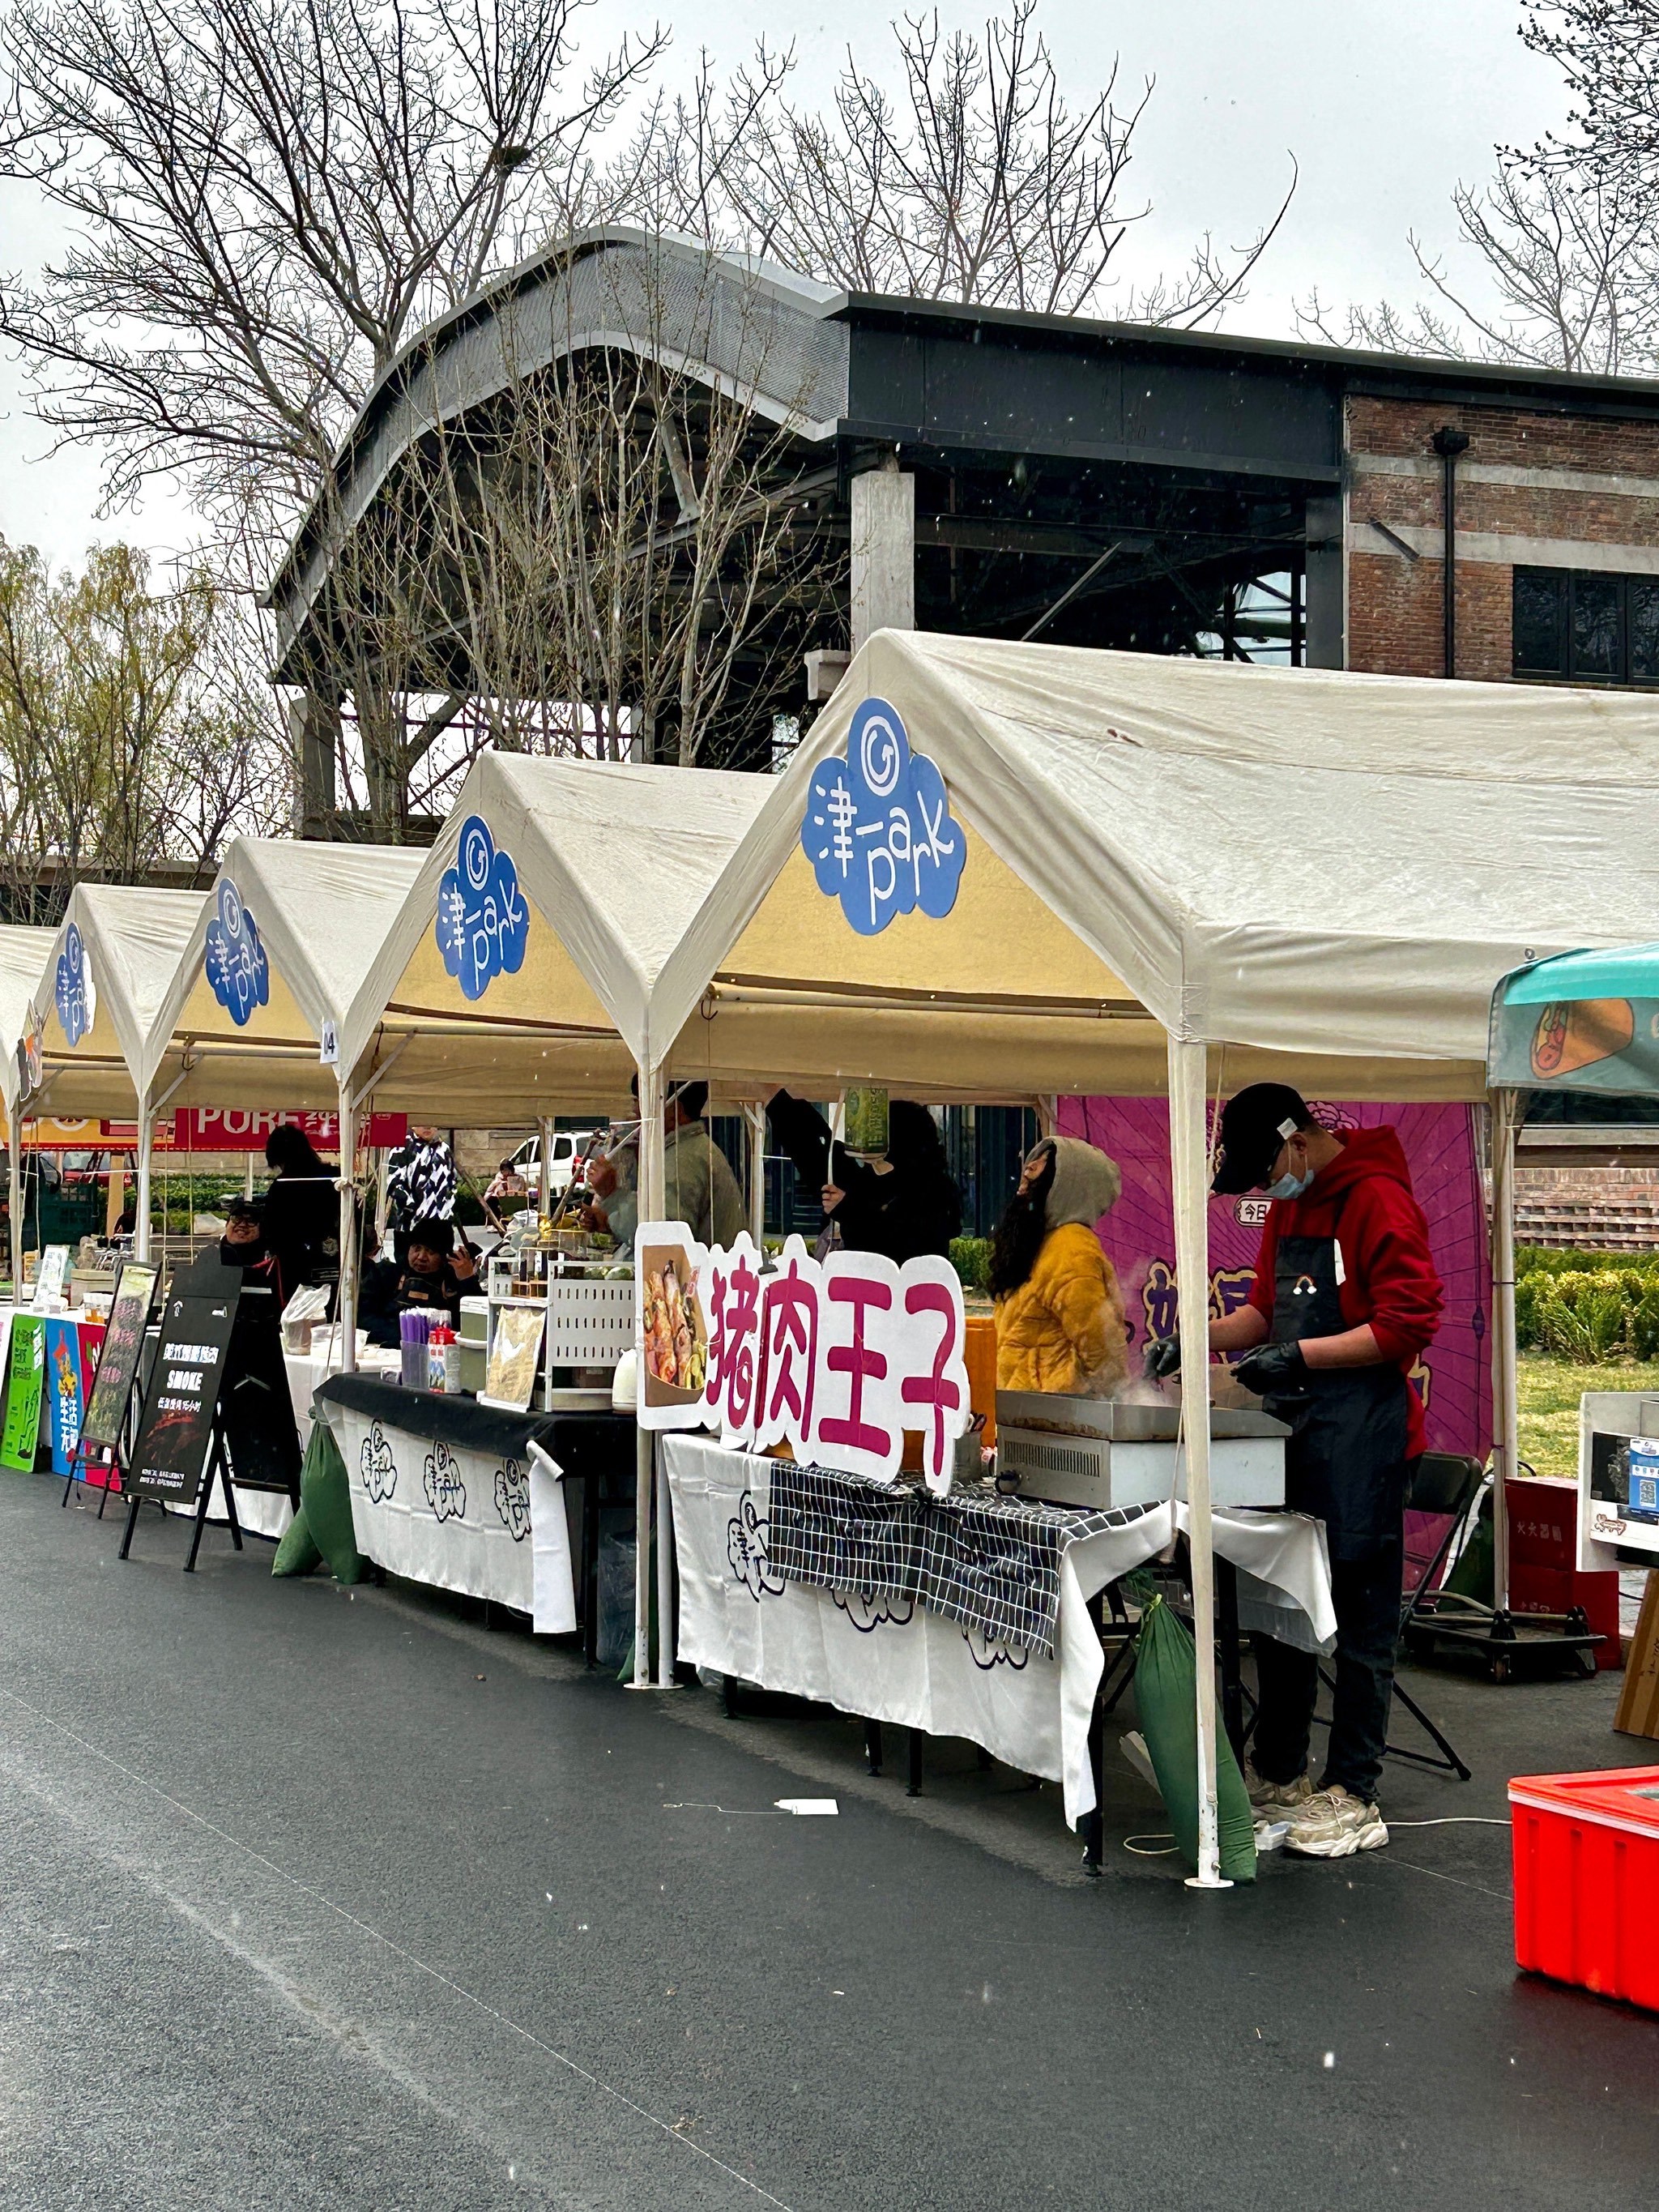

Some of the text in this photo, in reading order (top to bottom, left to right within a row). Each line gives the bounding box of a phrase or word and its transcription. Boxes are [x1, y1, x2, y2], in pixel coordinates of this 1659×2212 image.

[867, 790, 954, 925] park
[472, 879, 522, 991] park
[166, 1369, 203, 1391] SMOKE
[706, 1253, 961, 1476] 猪肉王子
